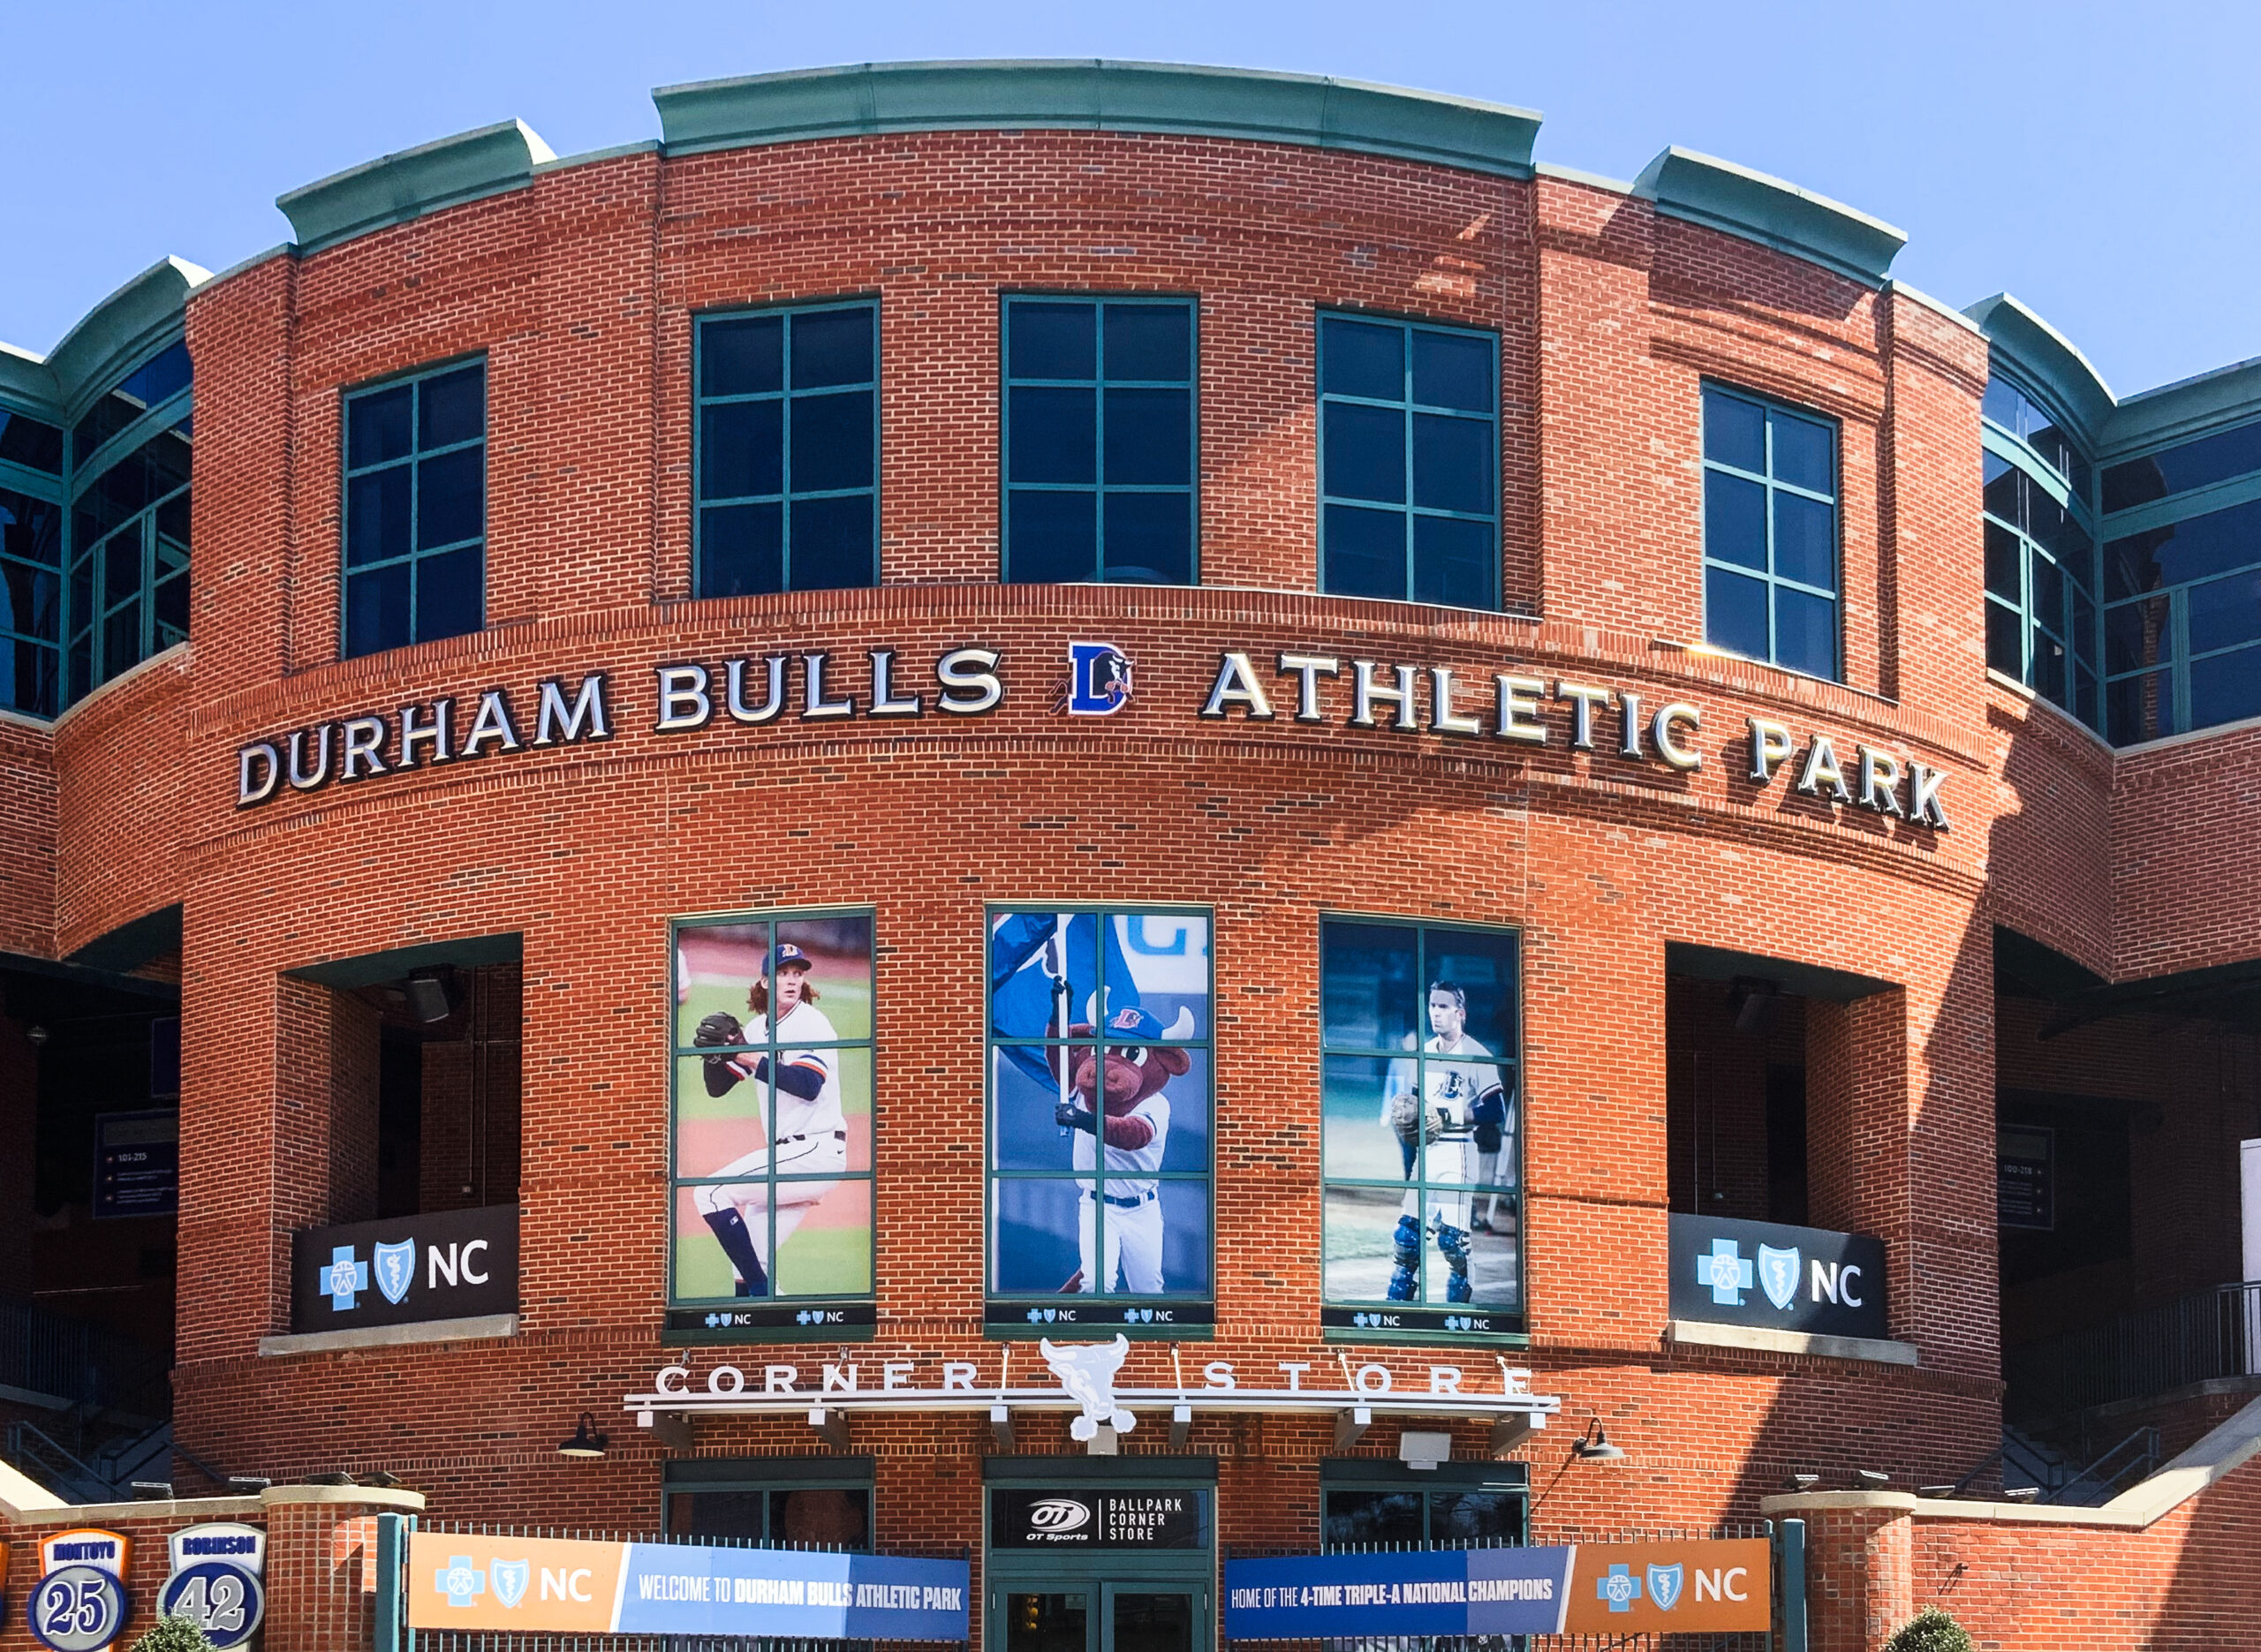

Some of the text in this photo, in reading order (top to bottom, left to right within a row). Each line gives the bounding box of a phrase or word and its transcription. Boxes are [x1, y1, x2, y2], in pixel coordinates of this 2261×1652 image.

[237, 674, 613, 810] DURHAM
[654, 648, 1003, 734] BULLS
[1199, 653, 1703, 771] ATHLETIC
[1745, 717, 1952, 832] PARK
[428, 1240, 488, 1289] NC
[1811, 1259, 1862, 1308] NC
[734, 1313, 752, 1325] NC
[827, 1311, 843, 1323] NC
[1059, 1309, 1077, 1321] NC
[1155, 1310, 1173, 1322] NC
[1384, 1315, 1401, 1326] NC
[1473, 1319, 1489, 1331] NC
[655, 1362, 1533, 1396] CORNER STORE
[1109, 1498, 1182, 1512] BALLPARK
[1109, 1513, 1165, 1526] CORNER
[1046, 1533, 1089, 1542] Sports
[1109, 1528, 1153, 1540] STORE
[54, 1541, 116, 1561] MONTOYO
[182, 1535, 256, 1556] ROBINSON
[541, 1567, 592, 1602] NC
[639, 1574, 962, 1611] WELCOME TO DURHAM BULLS ATHLETIC PARK
[1231, 1579, 1553, 1609] HOME OF THE 4-TIME TRIPLE-A NATIONAL CHAMPIONS
[1695, 1567, 1748, 1602] NC
[42, 1578, 106, 1635] 25
[172, 1574, 246, 1631] 42
